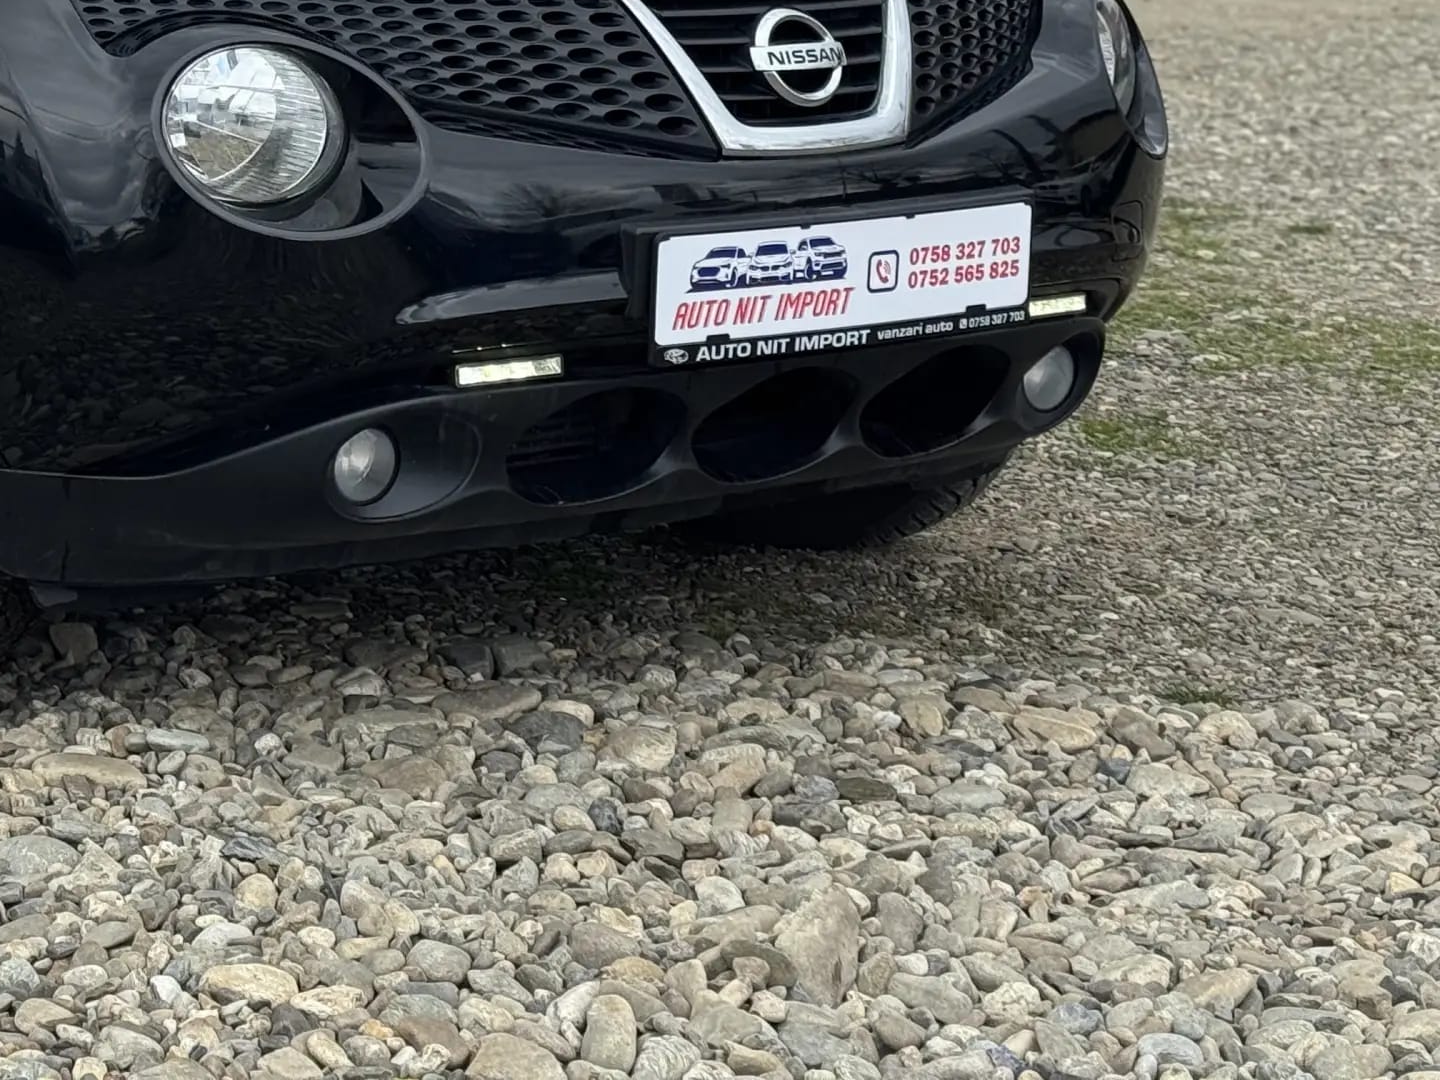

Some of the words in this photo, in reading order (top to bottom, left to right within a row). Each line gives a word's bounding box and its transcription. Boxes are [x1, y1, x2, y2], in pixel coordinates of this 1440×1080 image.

[767, 47, 844, 66] NISSAN
[909, 244, 952, 266] 0758
[955, 240, 986, 260] 327
[991, 236, 1021, 257] 703
[907, 268, 949, 289] 0752
[954, 263, 985, 284] 565
[989, 259, 1020, 280] 825
[672, 299, 731, 331] AUTO
[732, 294, 773, 326] NIT
[774, 286, 856, 321] IMPORT
[696, 342, 751, 362] AUTO
[756, 338, 792, 357] NIT
[794, 329, 871, 353] IMPORT
[877, 323, 923, 340] vanzari
[924, 320, 954, 335] auto
[968, 316, 990, 329] 0758
[991, 314, 1007, 326] 327
[1008, 310, 1026, 322] 703
